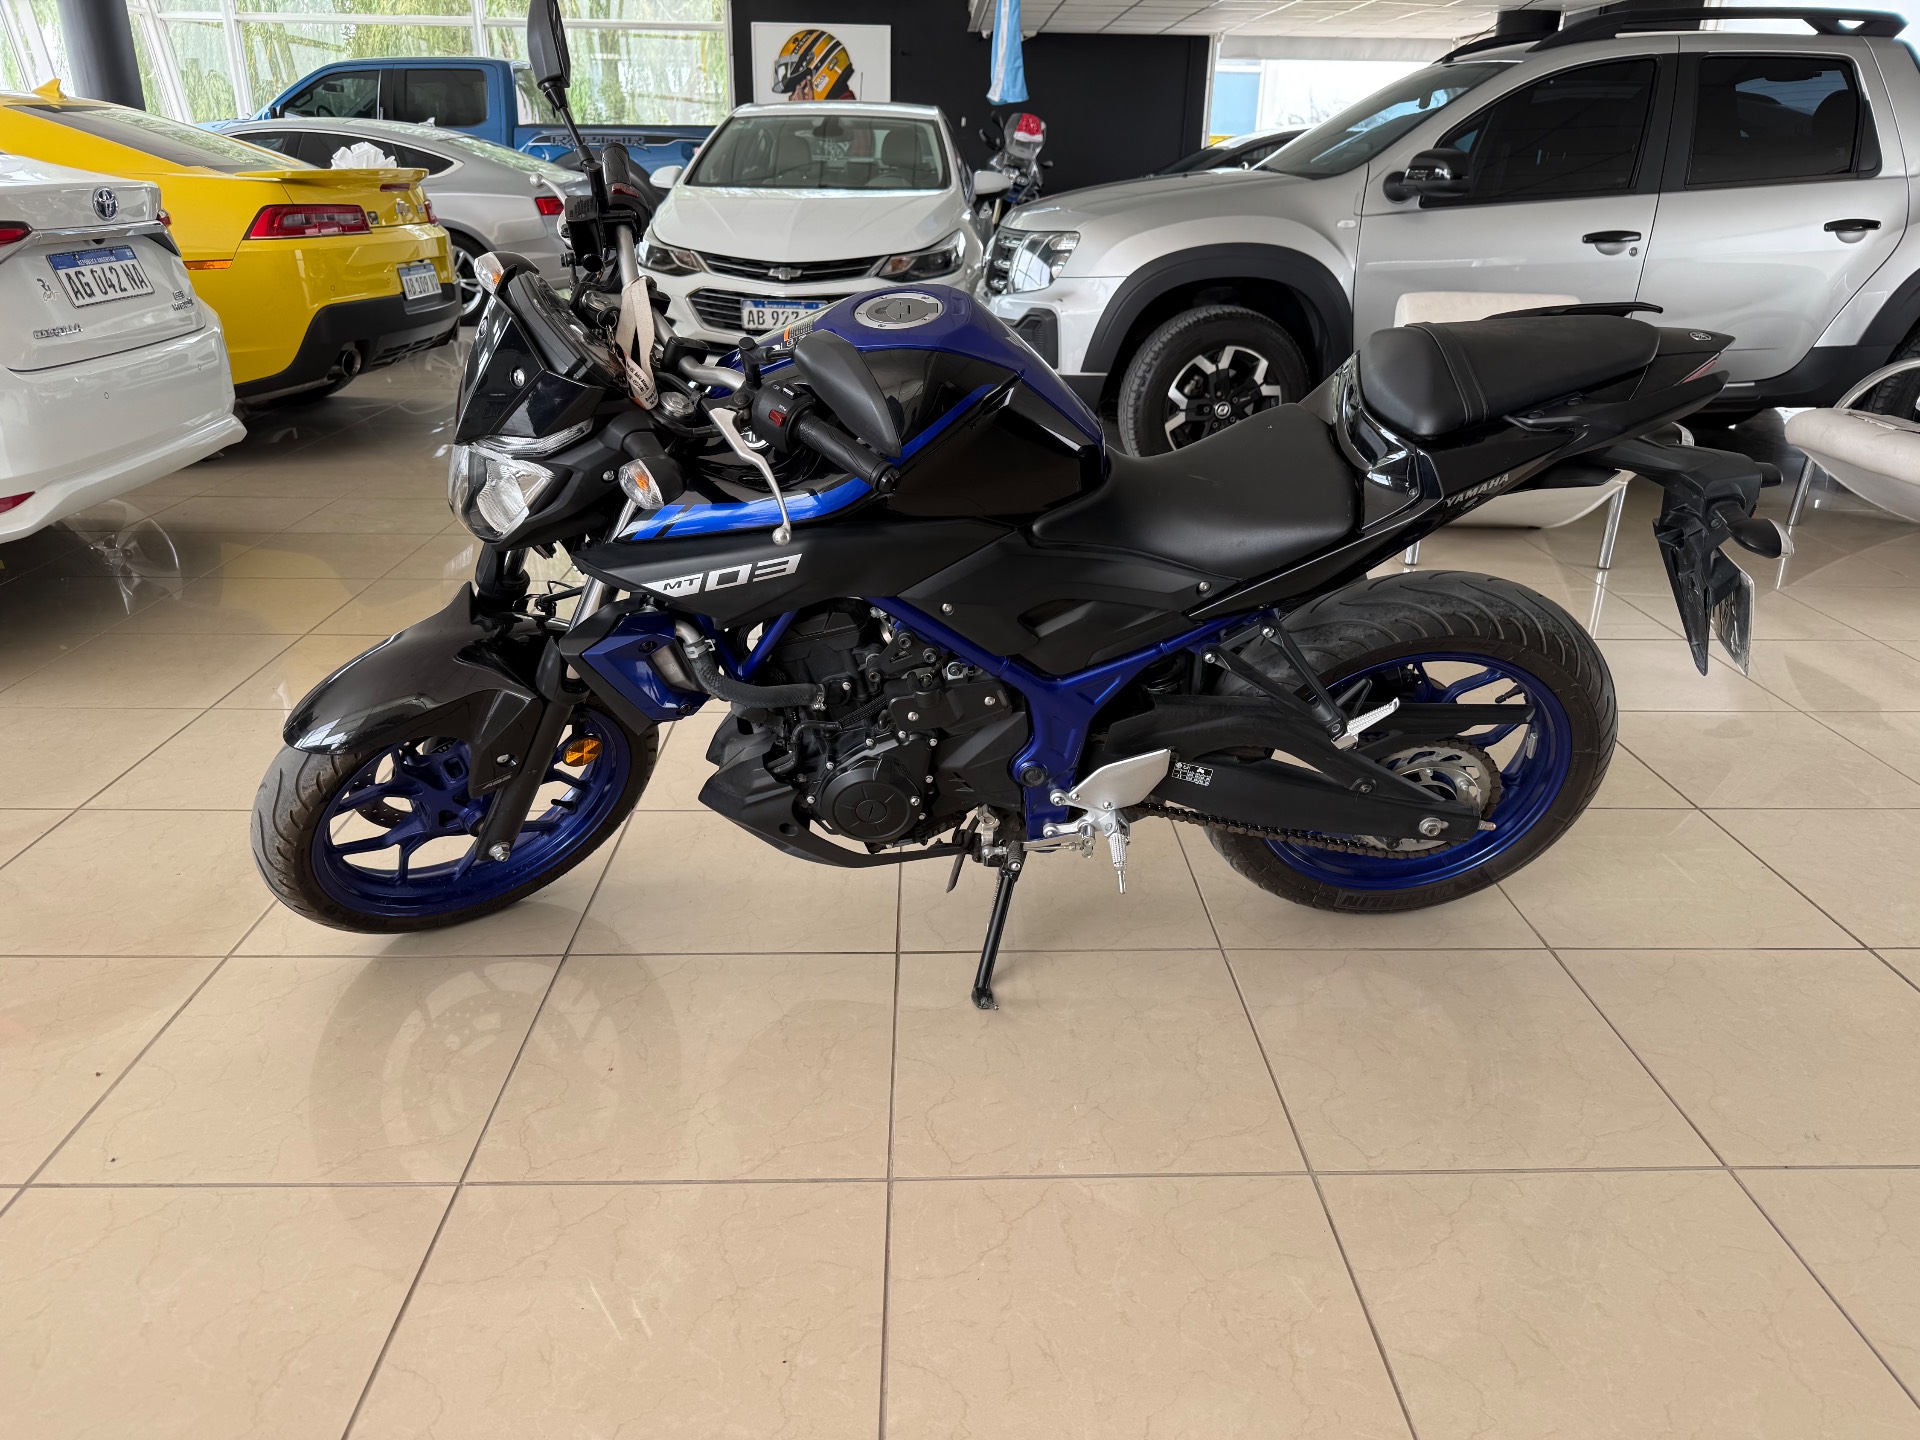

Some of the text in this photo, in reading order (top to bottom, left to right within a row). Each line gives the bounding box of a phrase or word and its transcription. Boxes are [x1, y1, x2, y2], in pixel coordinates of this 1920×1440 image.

[64, 270, 96, 302] AG
[90, 265, 128, 296] 042
[123, 262, 149, 291] NA
[747, 310, 765, 326] AB
[1446, 473, 1509, 508] YAMAHA
[662, 553, 803, 592] MT 03
